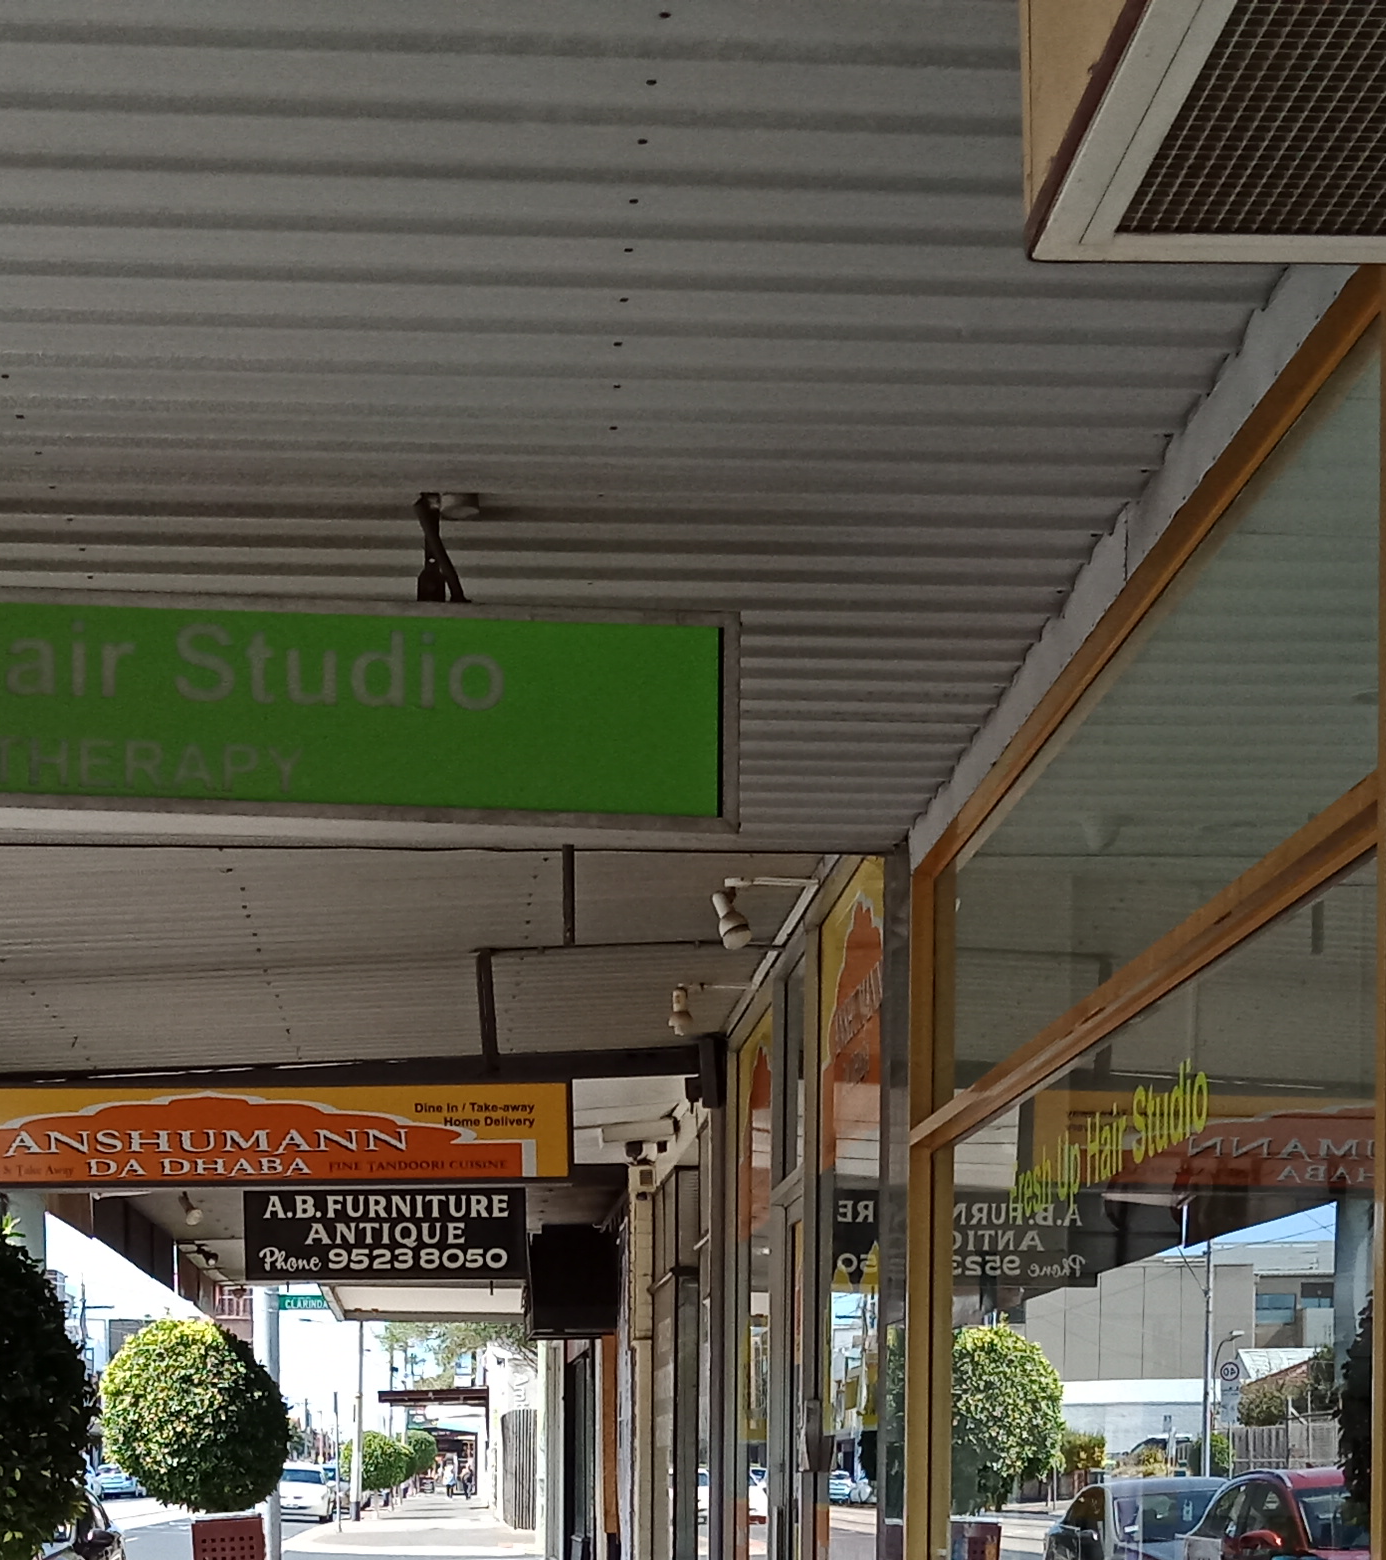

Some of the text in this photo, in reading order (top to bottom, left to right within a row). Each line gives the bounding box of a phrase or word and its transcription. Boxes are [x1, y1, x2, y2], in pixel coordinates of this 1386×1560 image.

[174, 622, 506, 712] Studio
[415, 1103, 443, 1114] Dine
[446, 1103, 459, 1114] In
[469, 1102, 536, 1115] Take-away
[444, 1116, 536, 1129] Home Delivery
[3, 1128, 409, 1159] ANSHUMANN
[1058, 1130, 1082, 1214] Up
[1087, 1102, 1128, 1188] Hair
[1132, 1057, 1208, 1165] Studio
[87, 1157, 313, 1178] DA DHABA
[329, 1160, 362, 1174] FINE
[368, 1159, 446, 1174] TANDOORI
[305, 1221, 467, 1248] ANTIQUE
[258, 1246, 509, 1273] Phone 9523 8050
[284, 1299, 329, 1309] CLARINDA
